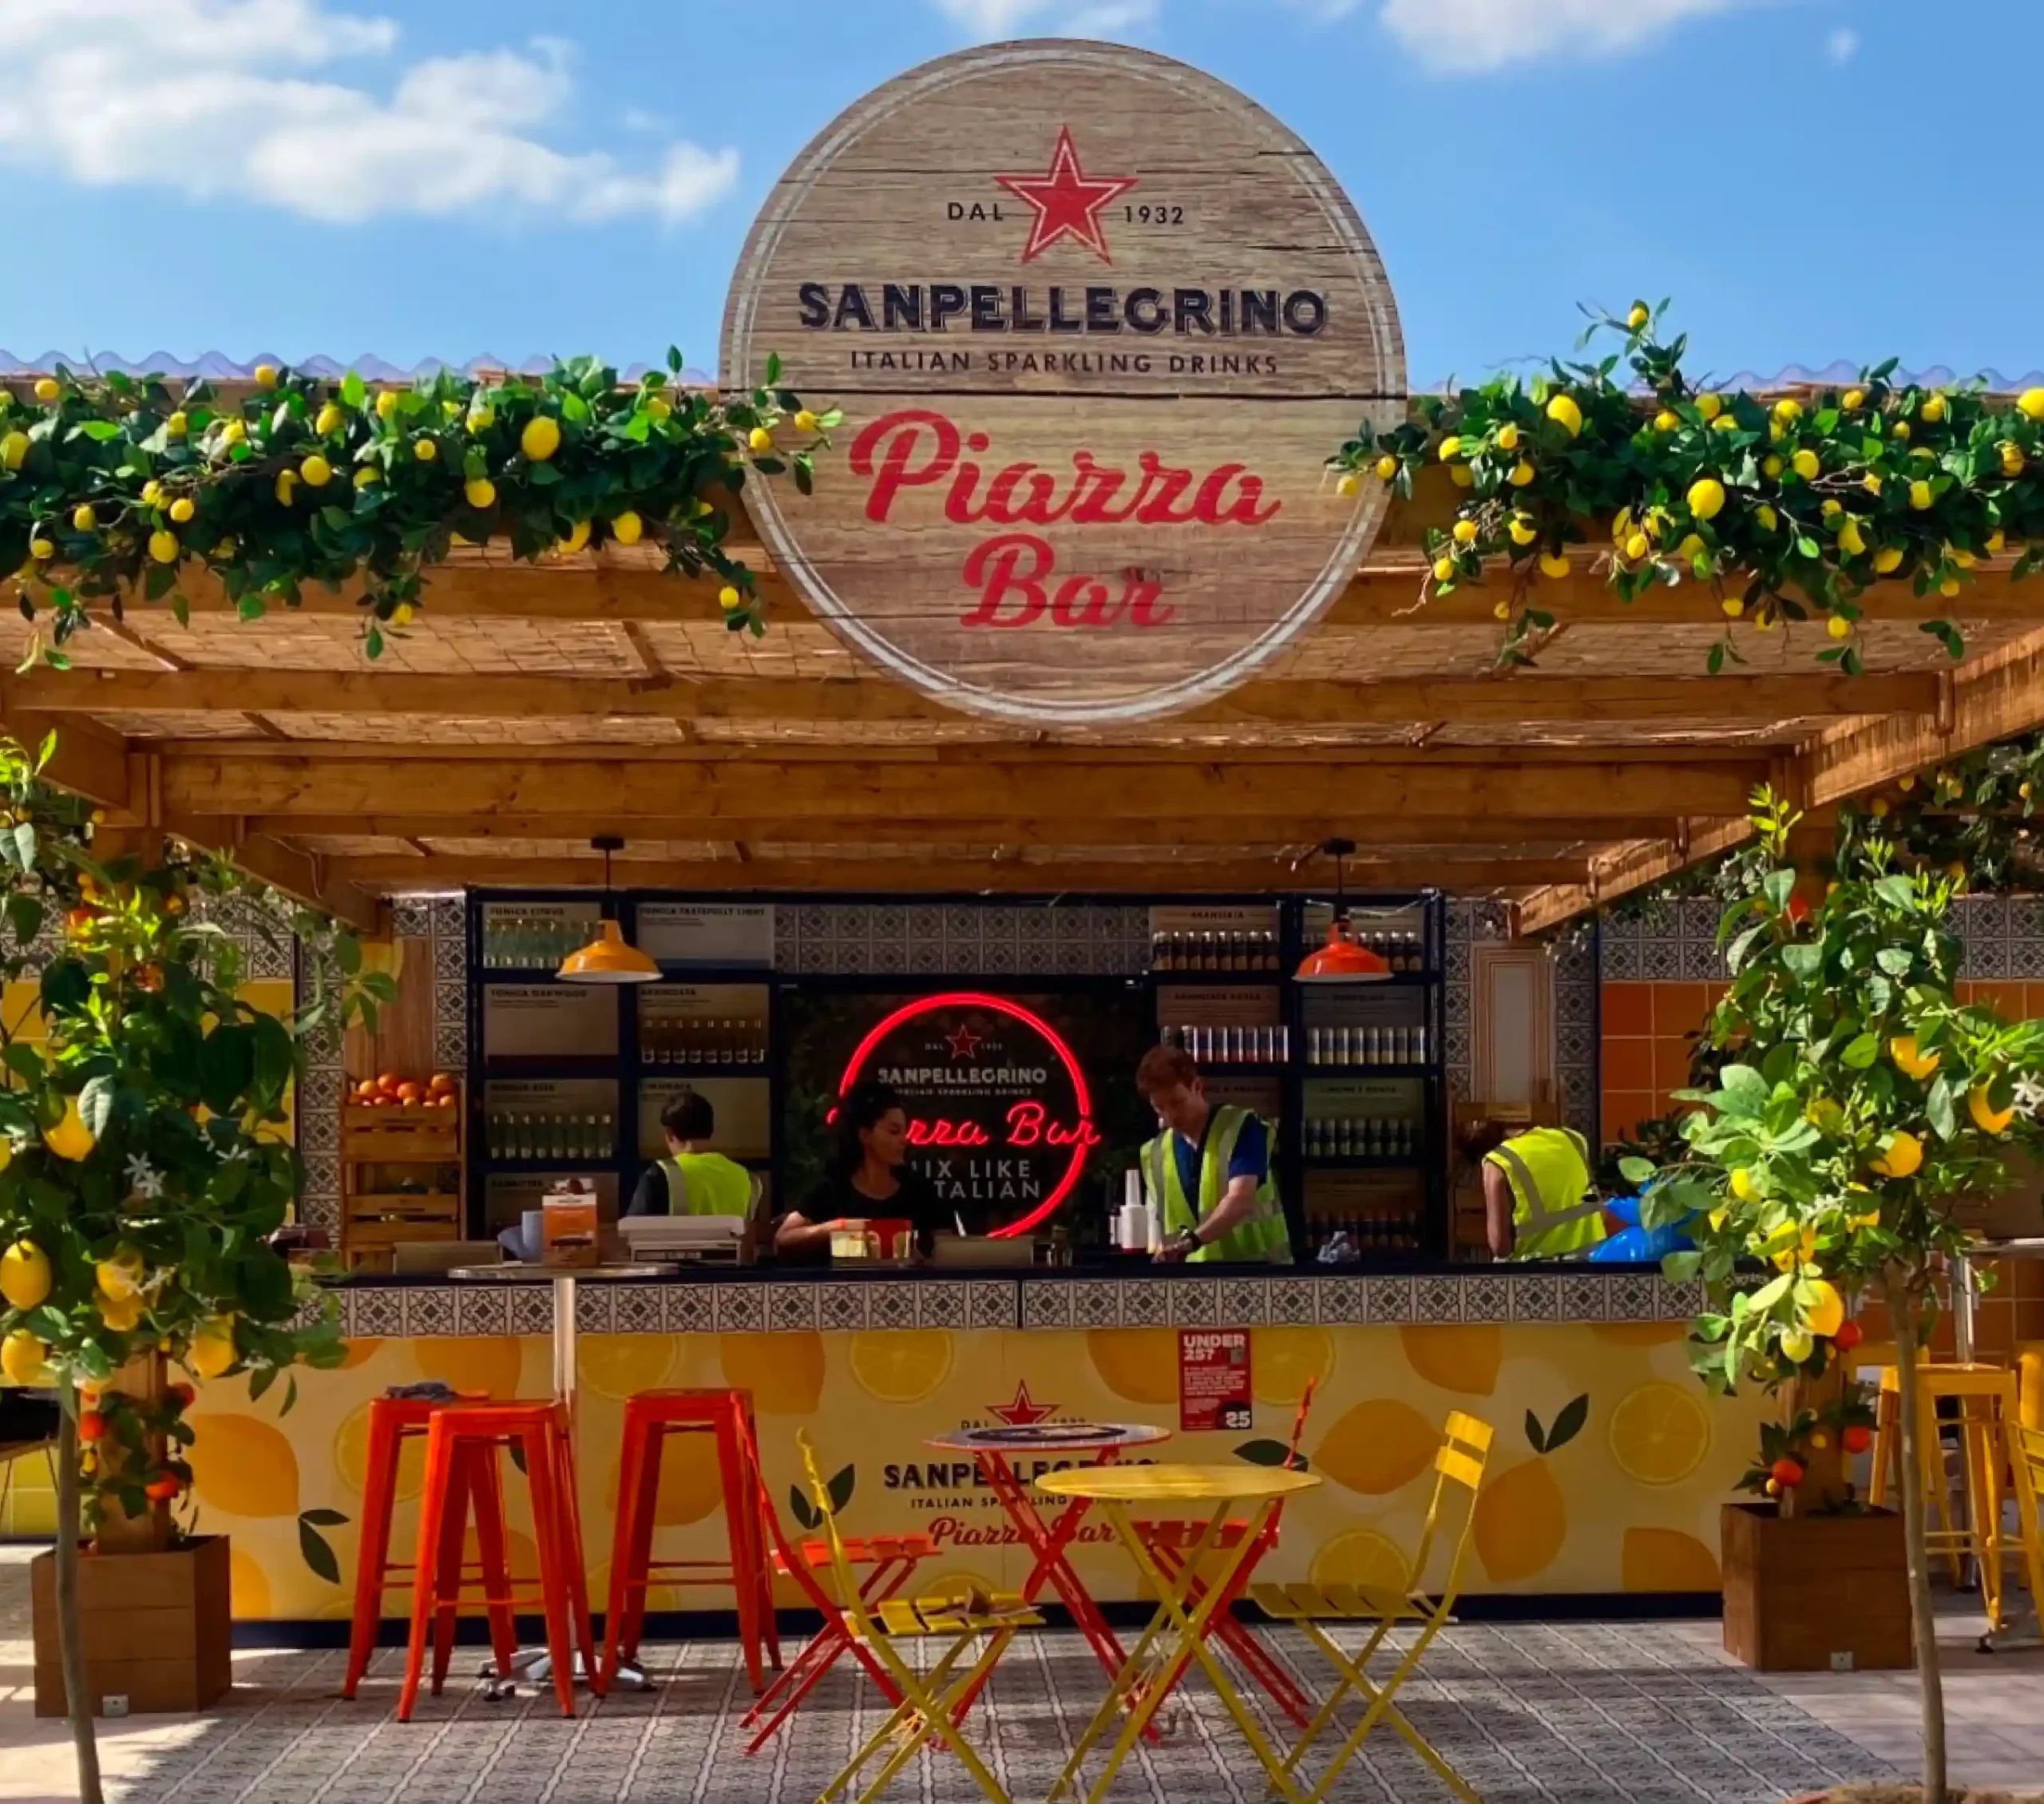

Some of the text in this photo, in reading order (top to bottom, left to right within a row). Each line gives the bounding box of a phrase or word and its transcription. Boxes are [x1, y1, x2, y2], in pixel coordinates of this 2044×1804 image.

[947, 202, 1183, 224] DAL 1932
[799, 282, 1329, 337] SANPELLEGRINO
[850, 351, 1278, 375] ITALIAN SPARKLING DRINKS
[850, 409, 1281, 525] Piazza
[960, 533, 1174, 628] Bar
[877, 1067, 1047, 1084] SANPELLEGRINO
[1006, 1101, 1102, 1145] Bar
[911, 1159, 1031, 1179] IX LIKE
[1182, 1333, 1245, 1348] UNDER
[1225, 1410, 1250, 1428] 25
[911, 1497, 973, 1509] ITALIAN
[928, 1517, 1031, 1547] Piazz
